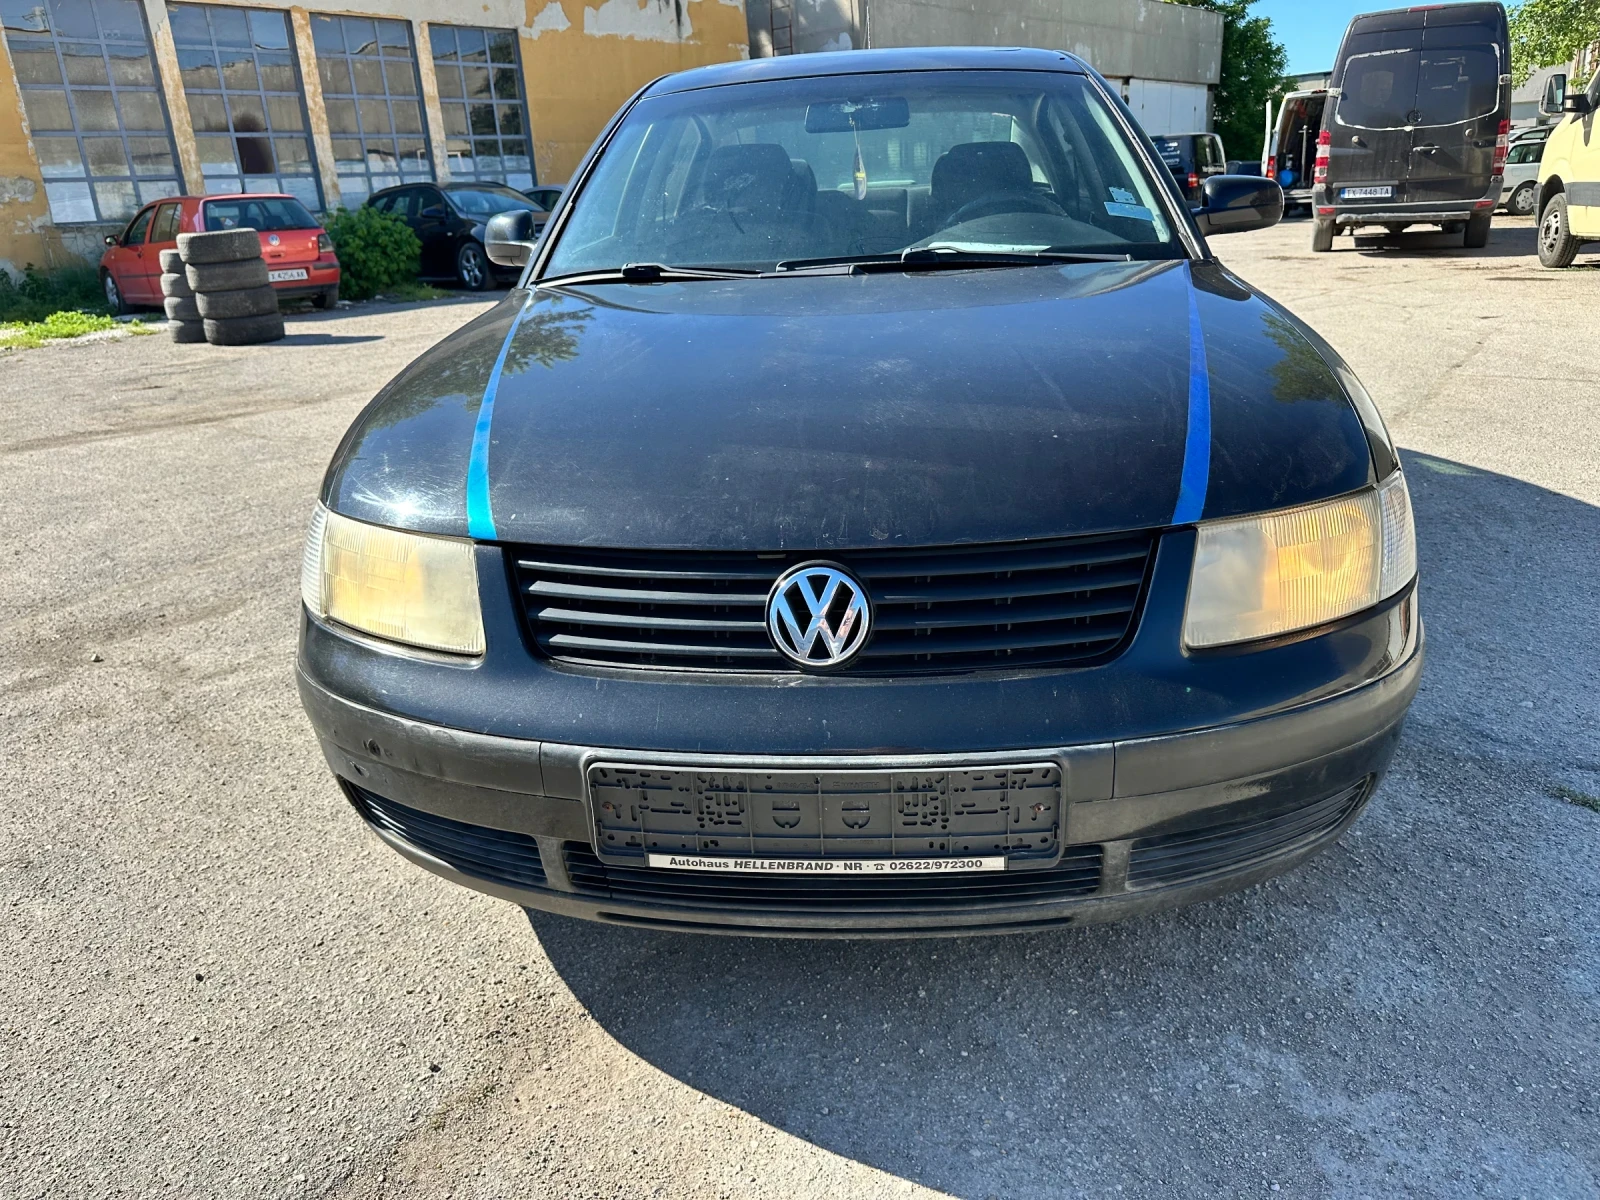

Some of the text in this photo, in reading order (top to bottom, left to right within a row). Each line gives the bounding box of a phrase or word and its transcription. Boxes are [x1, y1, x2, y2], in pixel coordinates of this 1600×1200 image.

[1358, 188, 1378, 196] 7448
[1380, 187, 1390, 195] TA
[669, 857, 983, 871] Autohaus HELLENBRAND NR 02622/972300
